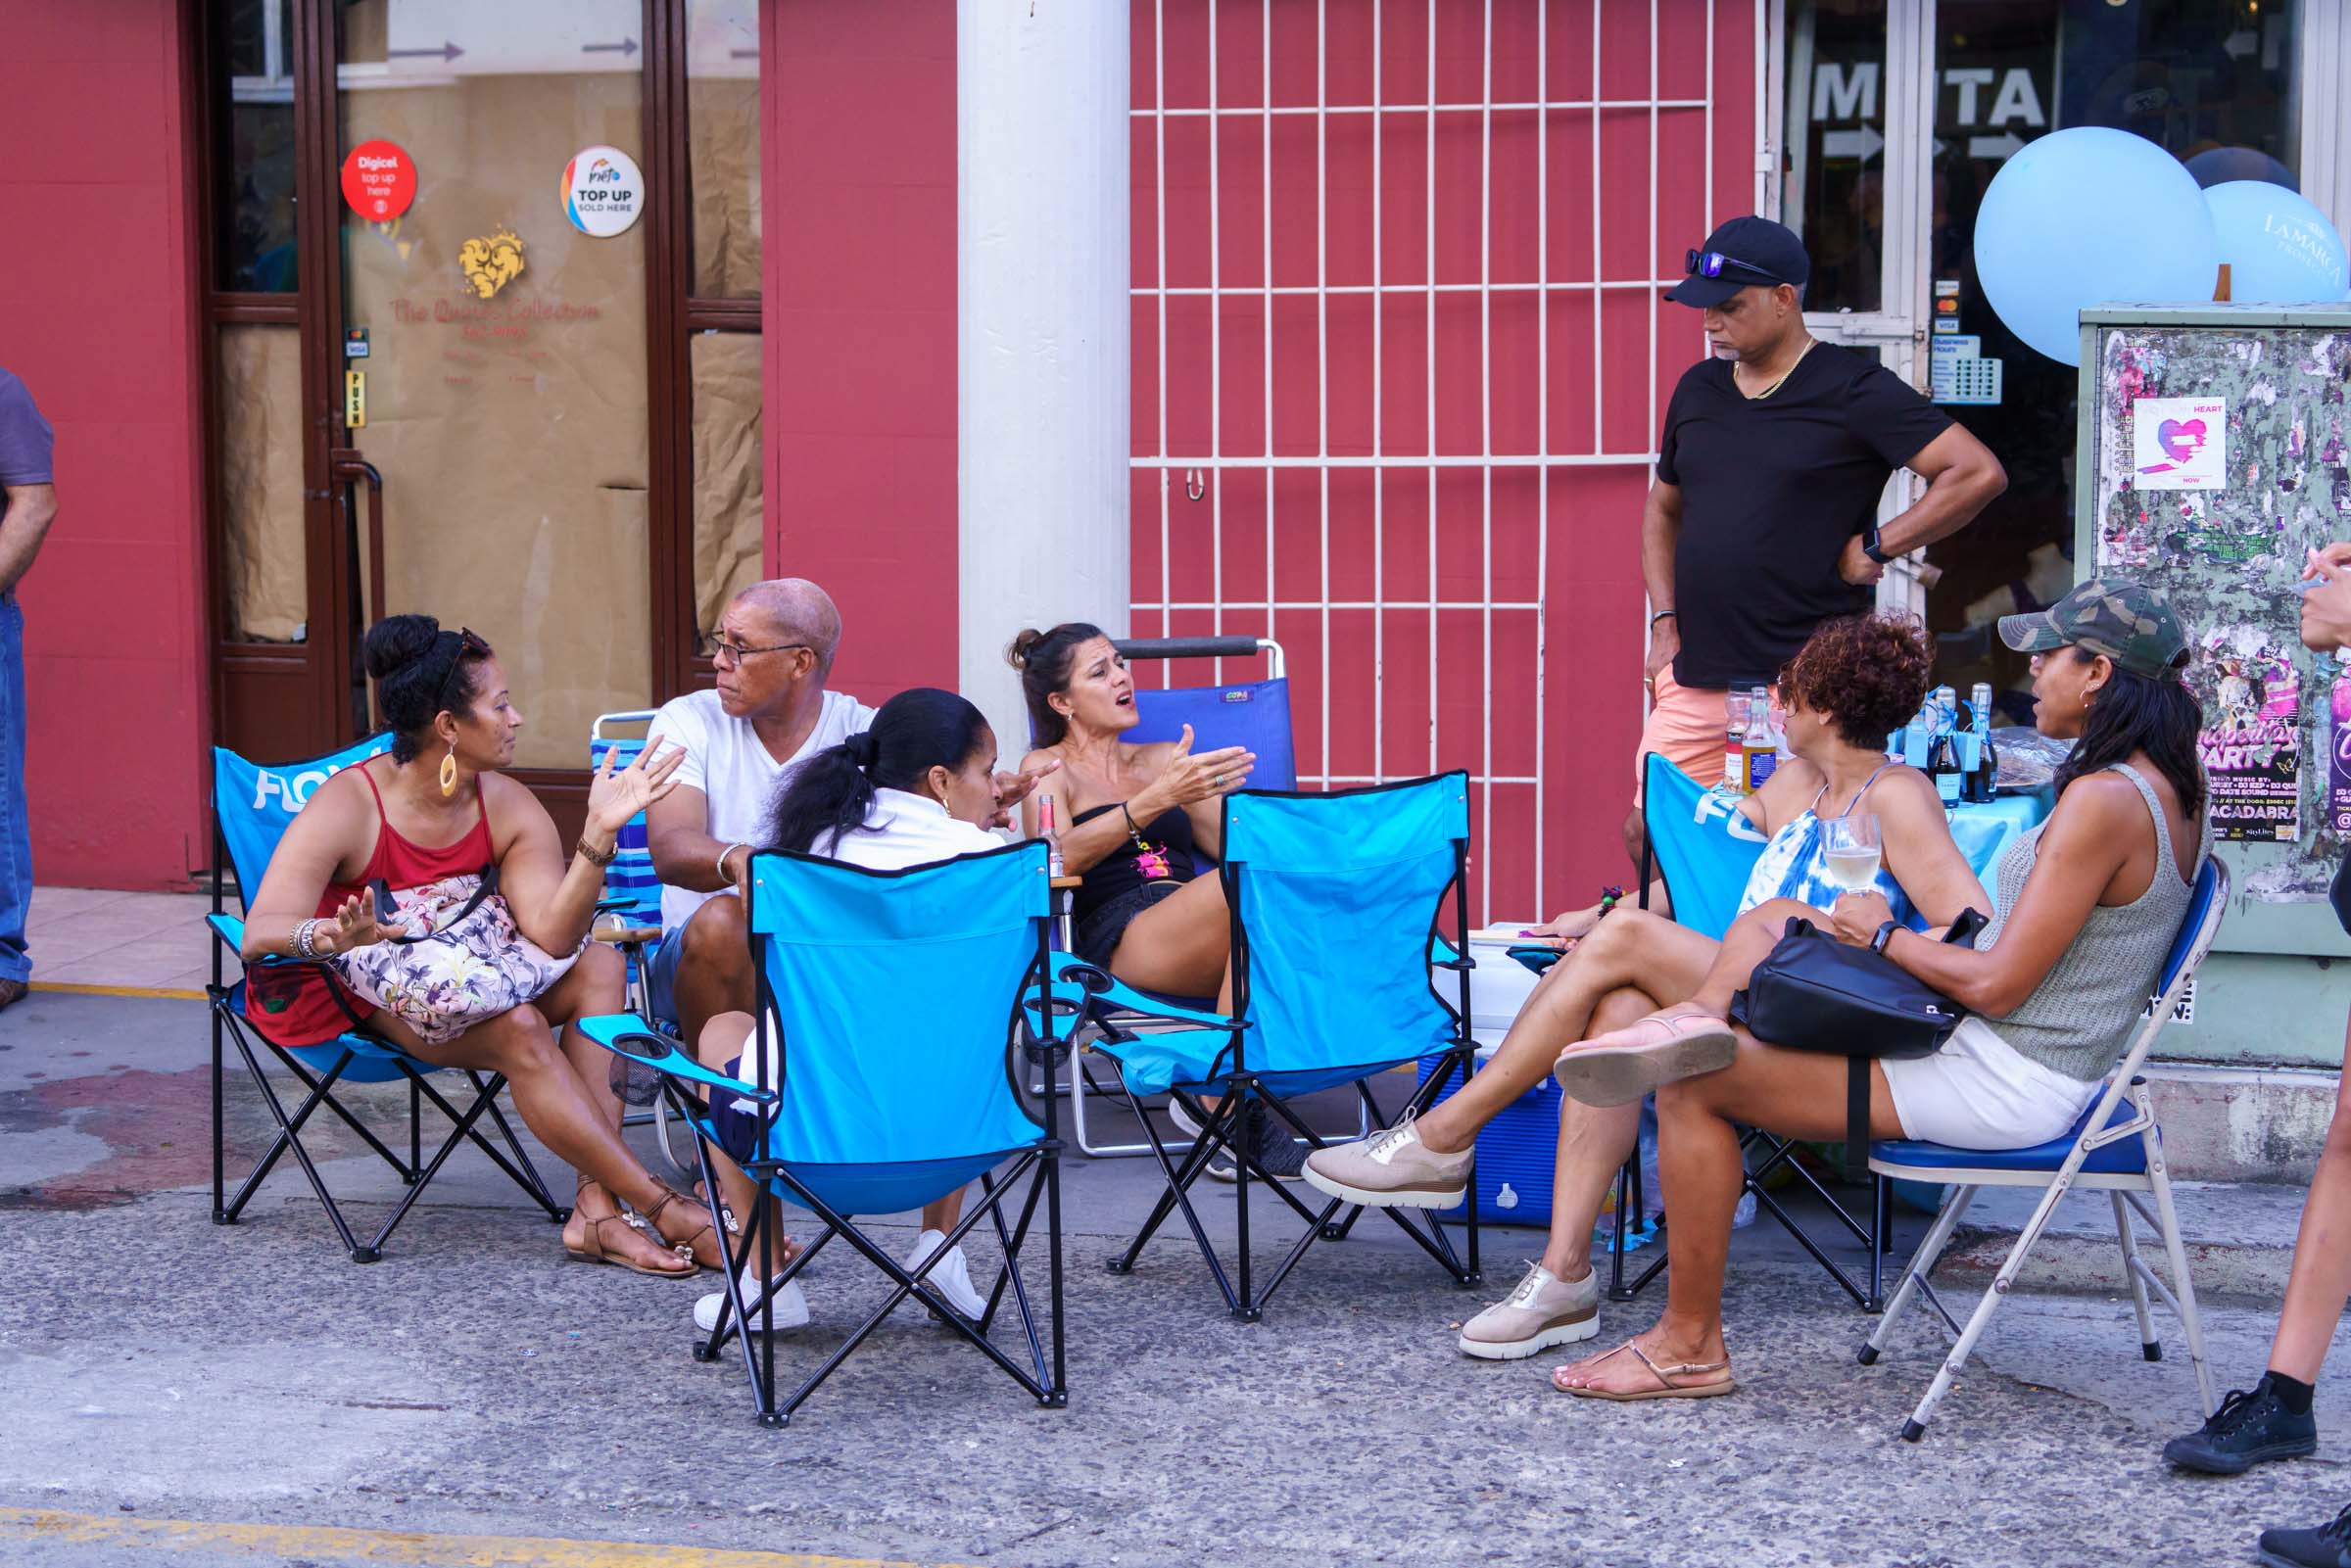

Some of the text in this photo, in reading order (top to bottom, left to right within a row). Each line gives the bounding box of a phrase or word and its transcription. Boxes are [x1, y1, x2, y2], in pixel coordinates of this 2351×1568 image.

[358, 156, 399, 170] Digicel
[361, 173, 396, 185] top up
[366, 186, 391, 196] here
[578, 189, 633, 202] TOP UP
[579, 203, 633, 213] SOLD HERE
